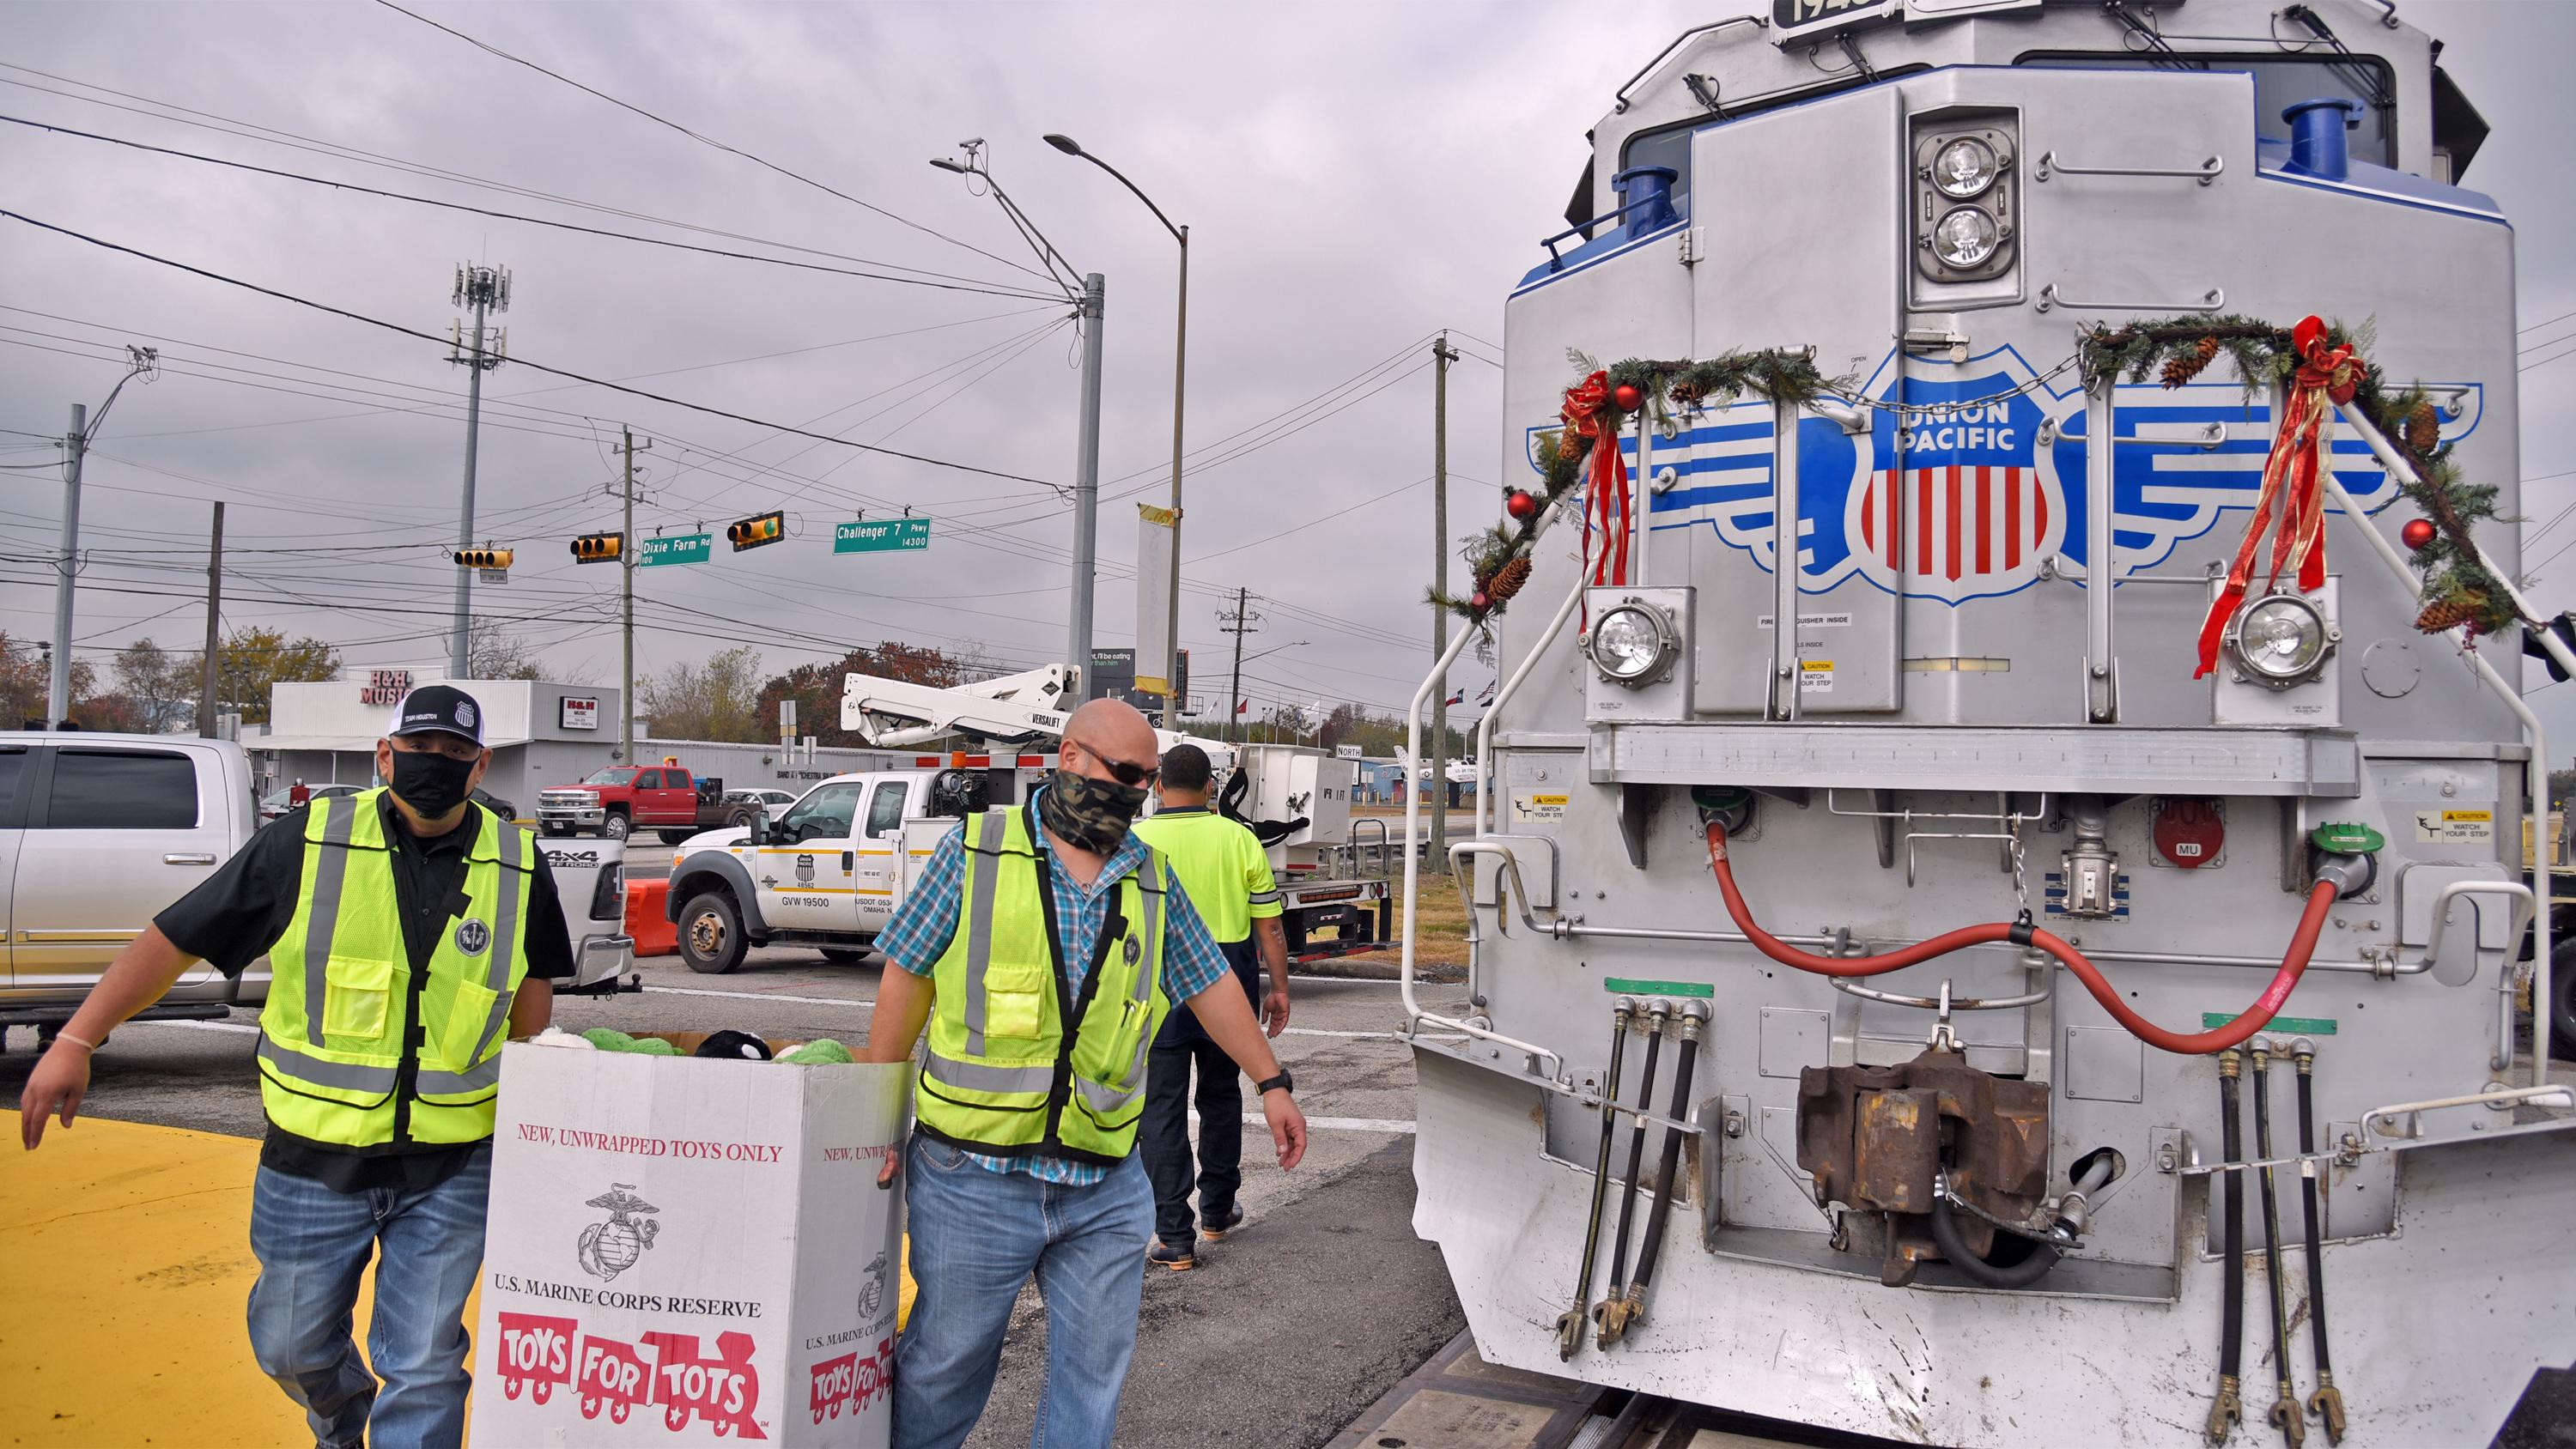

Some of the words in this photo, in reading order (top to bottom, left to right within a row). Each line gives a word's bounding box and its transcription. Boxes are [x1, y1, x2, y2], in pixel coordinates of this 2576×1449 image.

[1893, 427, 2014, 453] PACIFIC
[837, 525, 888, 541] Challenger
[895, 523, 902, 536] 7
[911, 524, 927, 534] Pkwy
[643, 542, 668, 555] Dixie
[673, 539, 696, 552] Farm
[701, 538, 711, 547] Rd
[902, 537, 926, 547] 14300
[641, 556, 653, 565] 100
[370, 670, 408, 687] H&H
[568, 700, 595, 710] H&H
[1032, 713, 1060, 728] VERSALIFT
[1338, 747, 1360, 757] NORTH
[796, 771, 822, 779] CHESTRA
[2178, 845, 2198, 855] MU
[782, 896, 800, 906] GVW
[803, 897, 829, 907] 19500
[518, 1123, 556, 1148] NEW,
[559, 1129, 666, 1156] UNWRAPPED
[671, 1140, 722, 1160] TOYS
[726, 1143, 784, 1163] ONLY
[823, 1147, 853, 1162] NEW,
[495, 1273, 521, 1293] U.S.
[525, 1279, 593, 1304] MARINE
[597, 1290, 662, 1312] CORPS
[666, 1297, 762, 1319] RESERVE
[805, 1337, 824, 1350] U.S.
[826, 1327, 864, 1347] MARINE
[504, 1327, 567, 1374] TOYS
[582, 1346, 641, 1397] FOR
[661, 1363, 746, 1415] TOTS
[815, 1364, 852, 1401] TOYS
[855, 1365, 876, 1391] FOR
